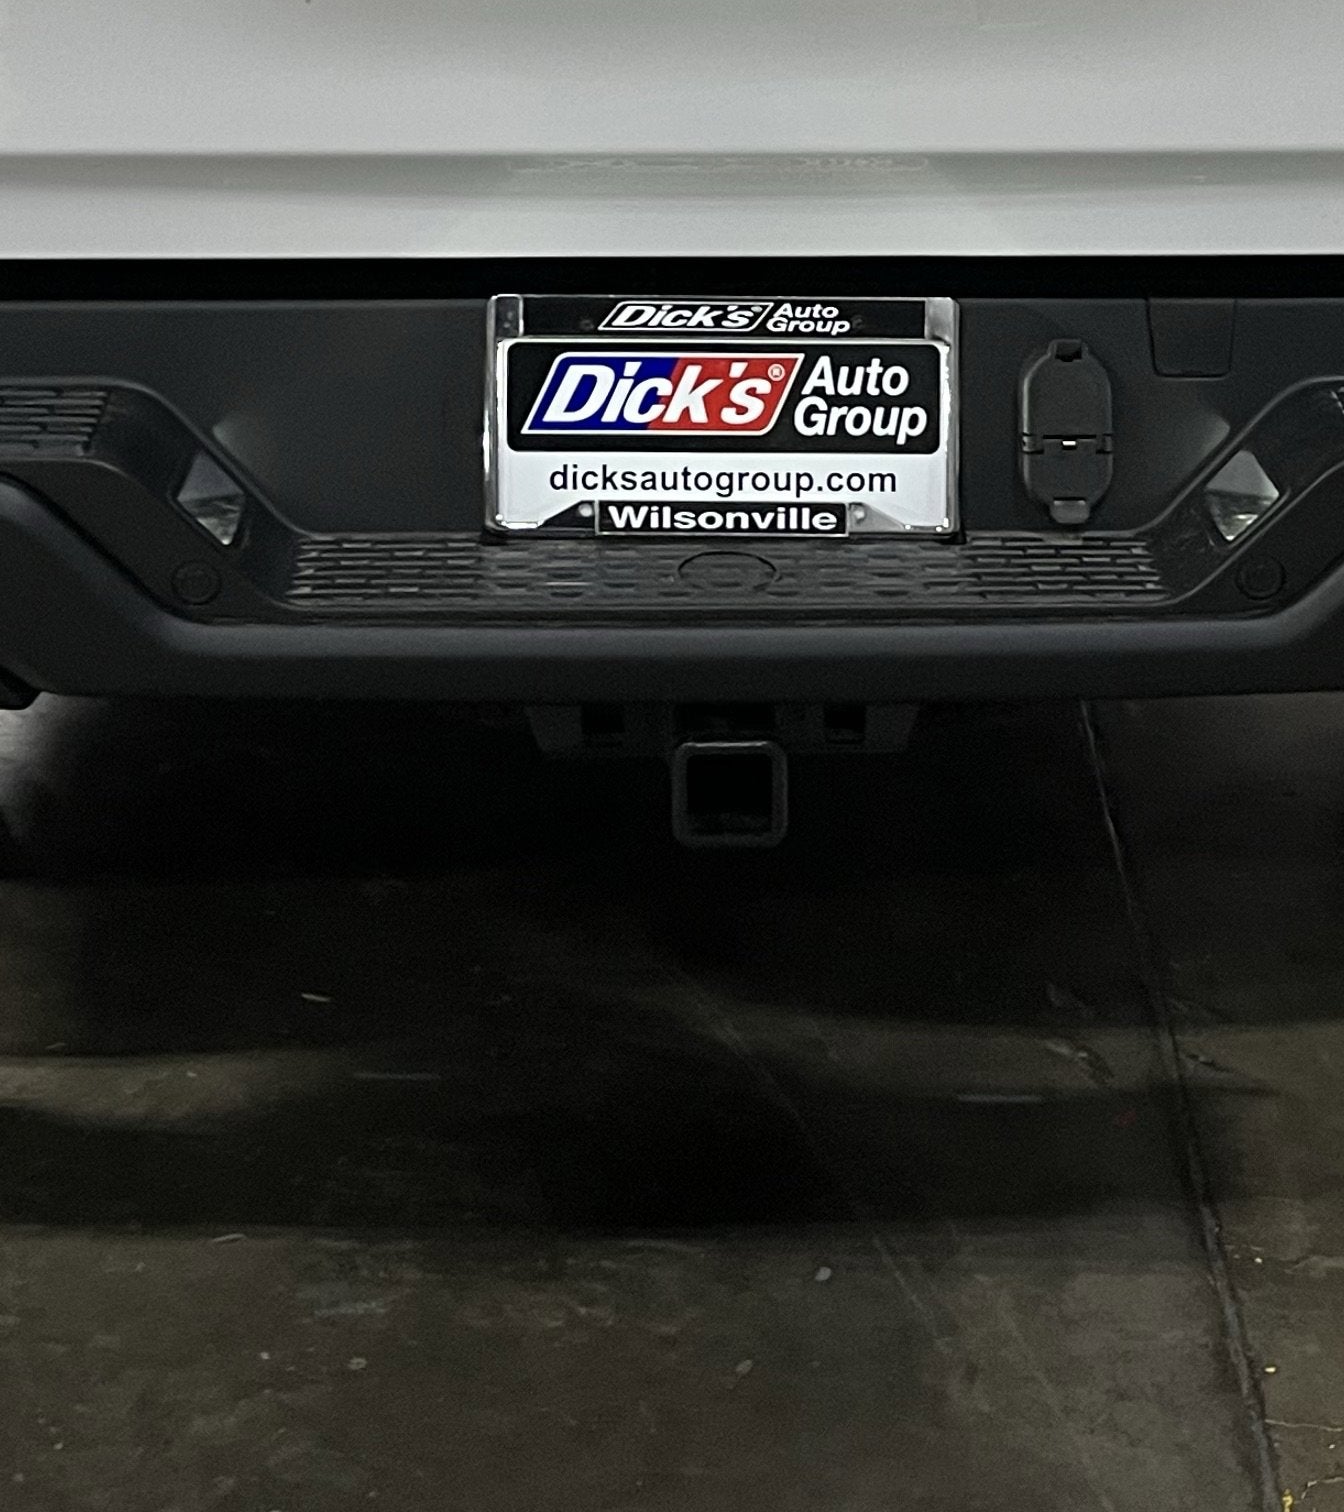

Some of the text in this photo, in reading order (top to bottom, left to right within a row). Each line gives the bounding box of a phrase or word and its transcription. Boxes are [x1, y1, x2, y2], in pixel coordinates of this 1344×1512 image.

[612, 304, 756, 329] Dick's
[766, 316, 851, 337] Group
[771, 302, 840, 320] Auto
[801, 354, 910, 397] Auto
[542, 361, 771, 425] Dick's
[793, 397, 928, 444] Group
[548, 463, 897, 498] dicksautogroup.com
[607, 504, 838, 532] Wilsonville
